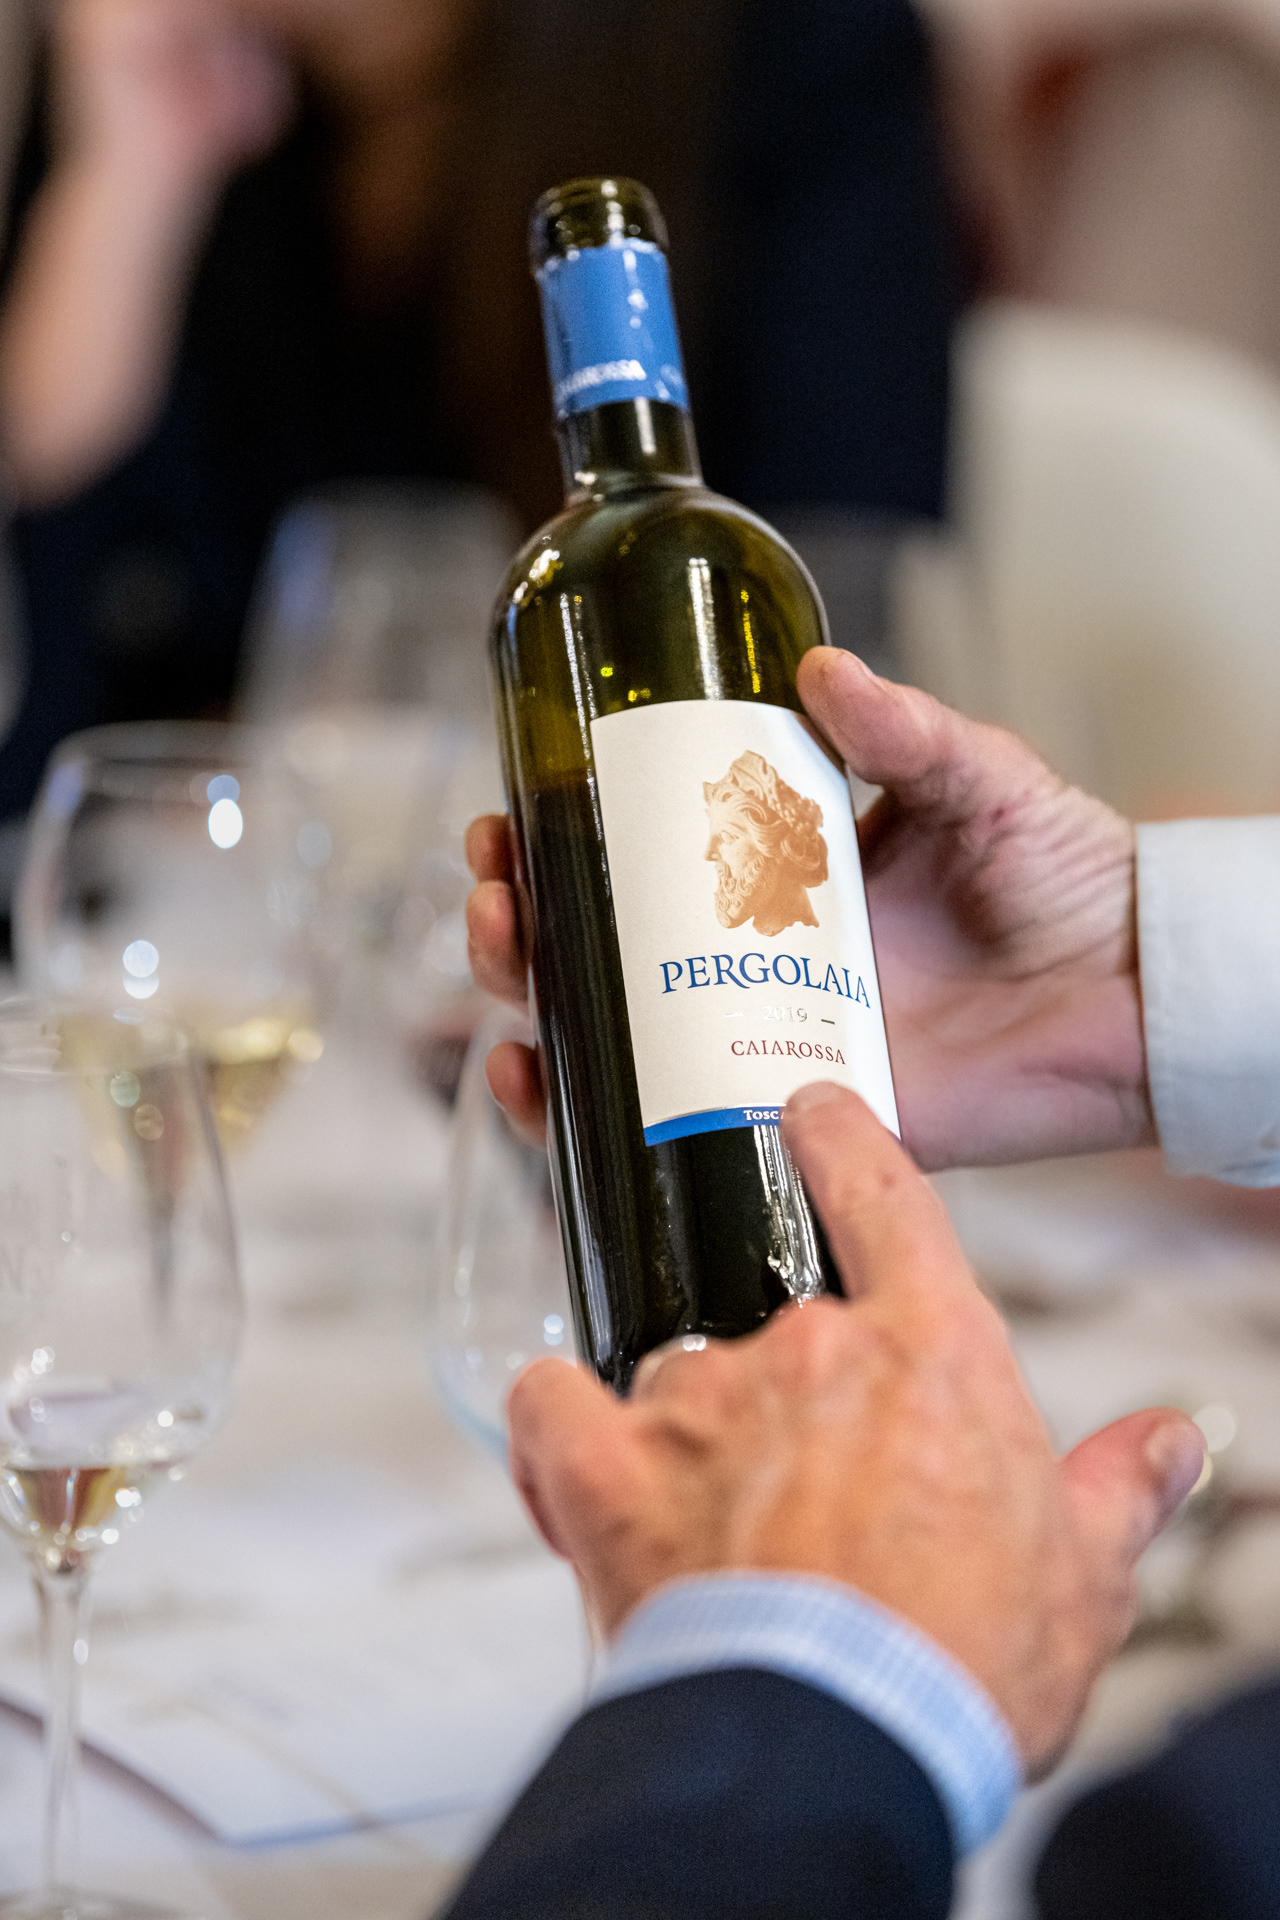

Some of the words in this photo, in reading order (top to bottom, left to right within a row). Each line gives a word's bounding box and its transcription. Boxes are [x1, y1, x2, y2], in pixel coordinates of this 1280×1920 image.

[659, 953, 871, 1009] PERGOLAIA
[762, 1005, 808, 1023] 2019
[731, 1039, 846, 1065] CAIAROSSA
[743, 1109, 785, 1121] TOSC
